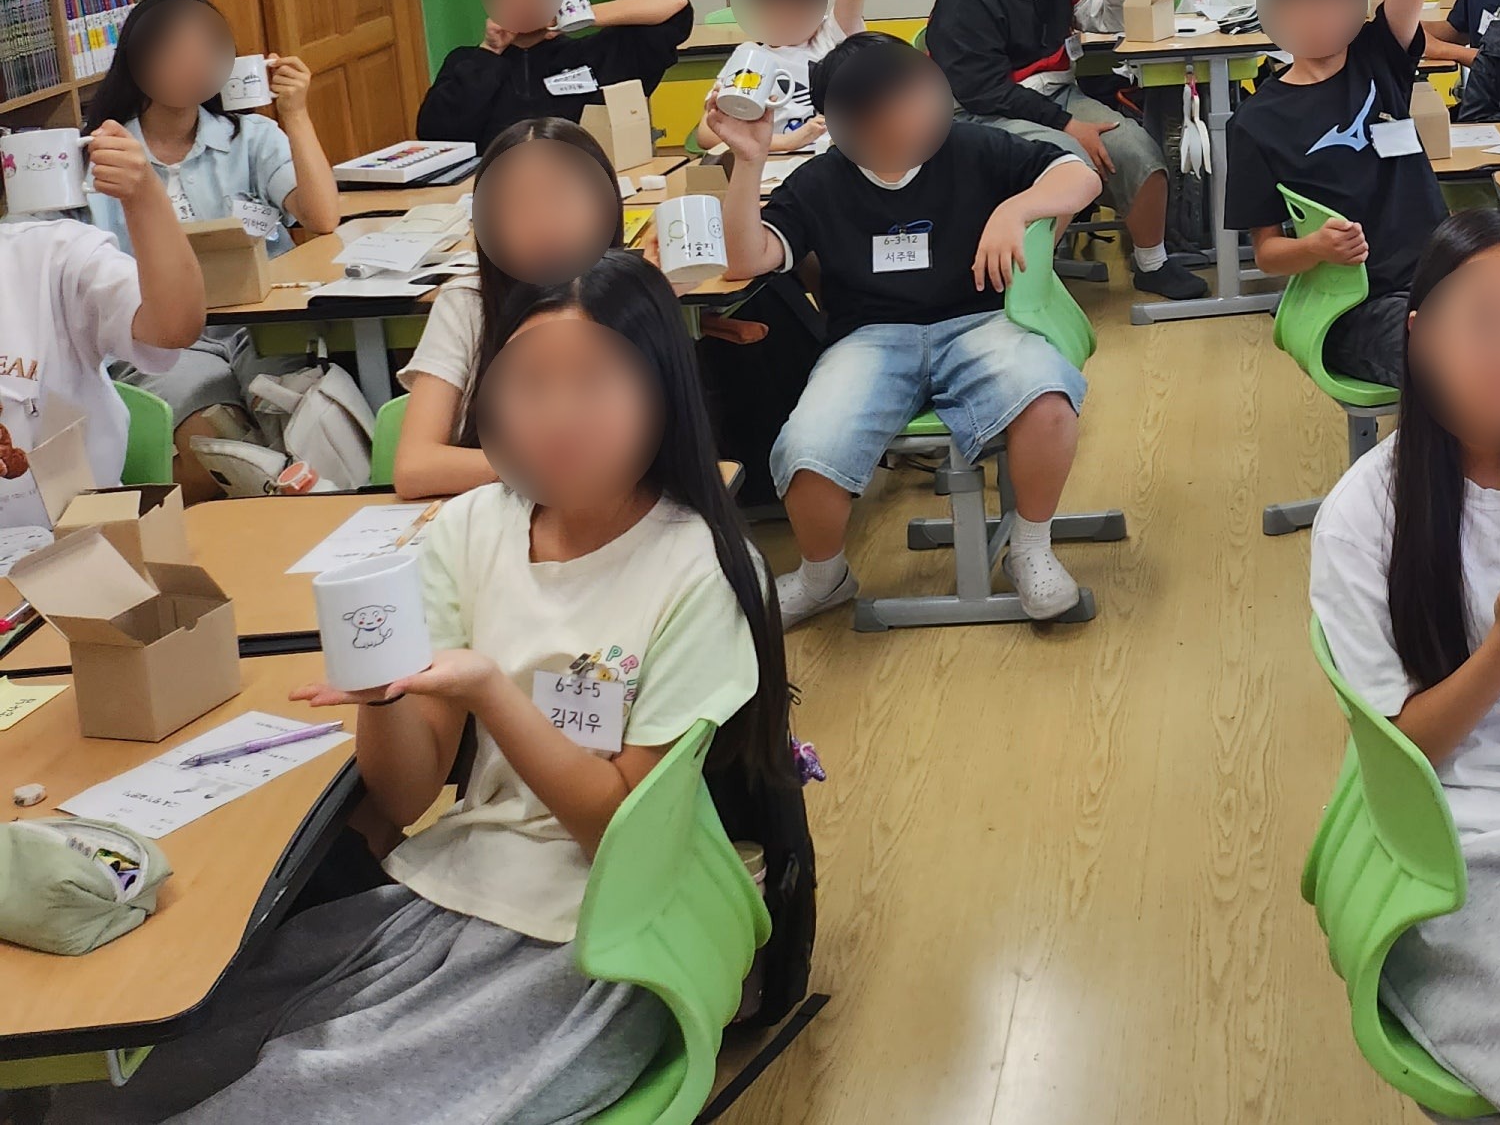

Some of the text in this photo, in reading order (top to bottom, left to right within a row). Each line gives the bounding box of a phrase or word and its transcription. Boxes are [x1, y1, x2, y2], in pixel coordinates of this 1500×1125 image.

[884, 235, 918, 245] 6-3-12
[885, 250, 916, 263] 서주원
[555, 676, 601, 698] 6-3-5
[550, 707, 602, 733] 김지우
